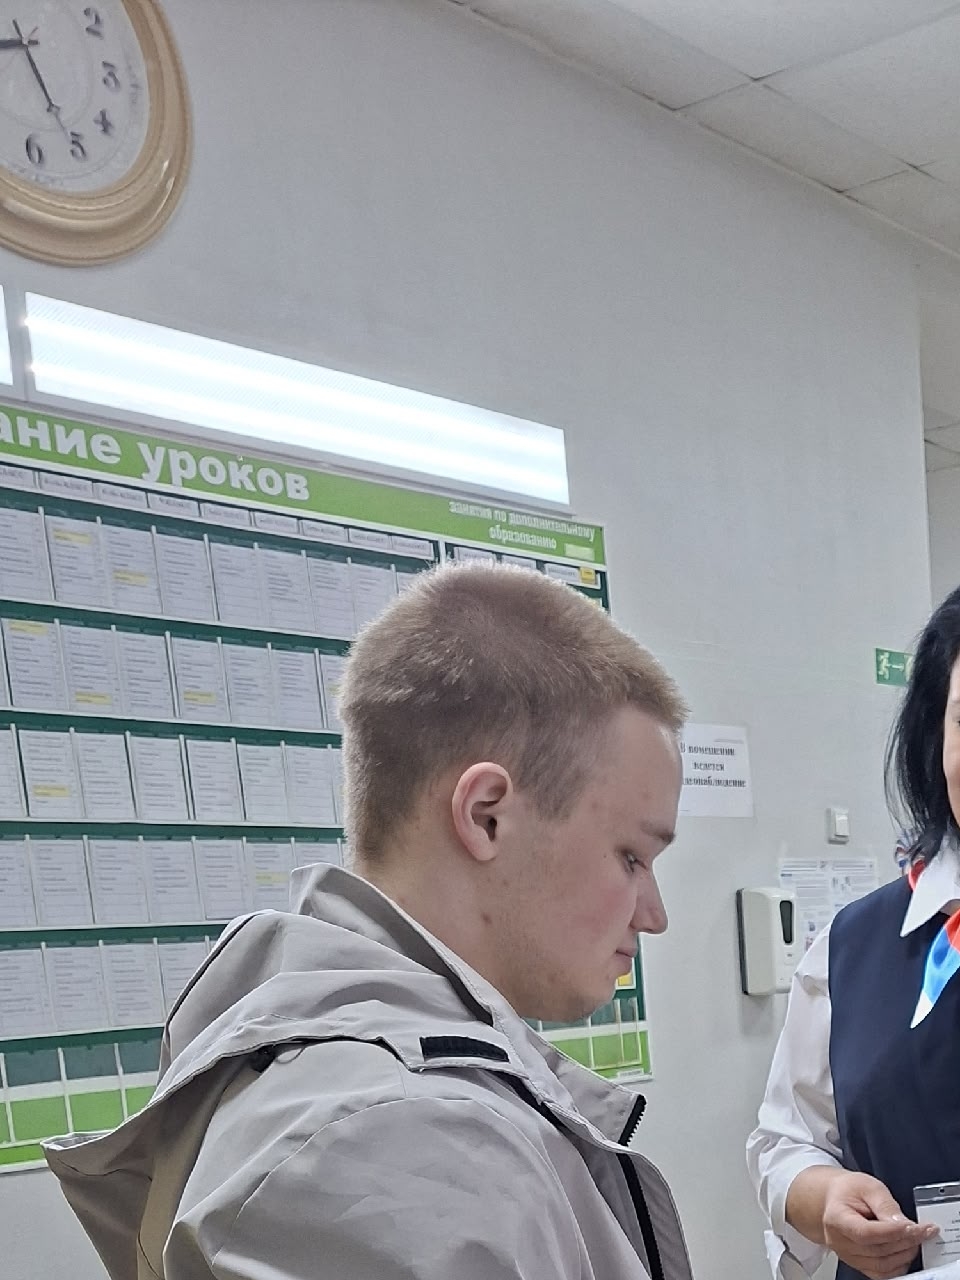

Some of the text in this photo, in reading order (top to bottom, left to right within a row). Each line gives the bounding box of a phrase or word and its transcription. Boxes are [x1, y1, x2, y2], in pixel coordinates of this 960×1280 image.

[84, 7, 103, 40] 2
[26, 134, 44, 164] 6
[70, 132, 88, 162] 5
[137, 440, 311, 501] уроков
[489, 524, 557, 549] образованию
[494, 510, 507, 523] по
[508, 511, 596, 542] дополнительному
